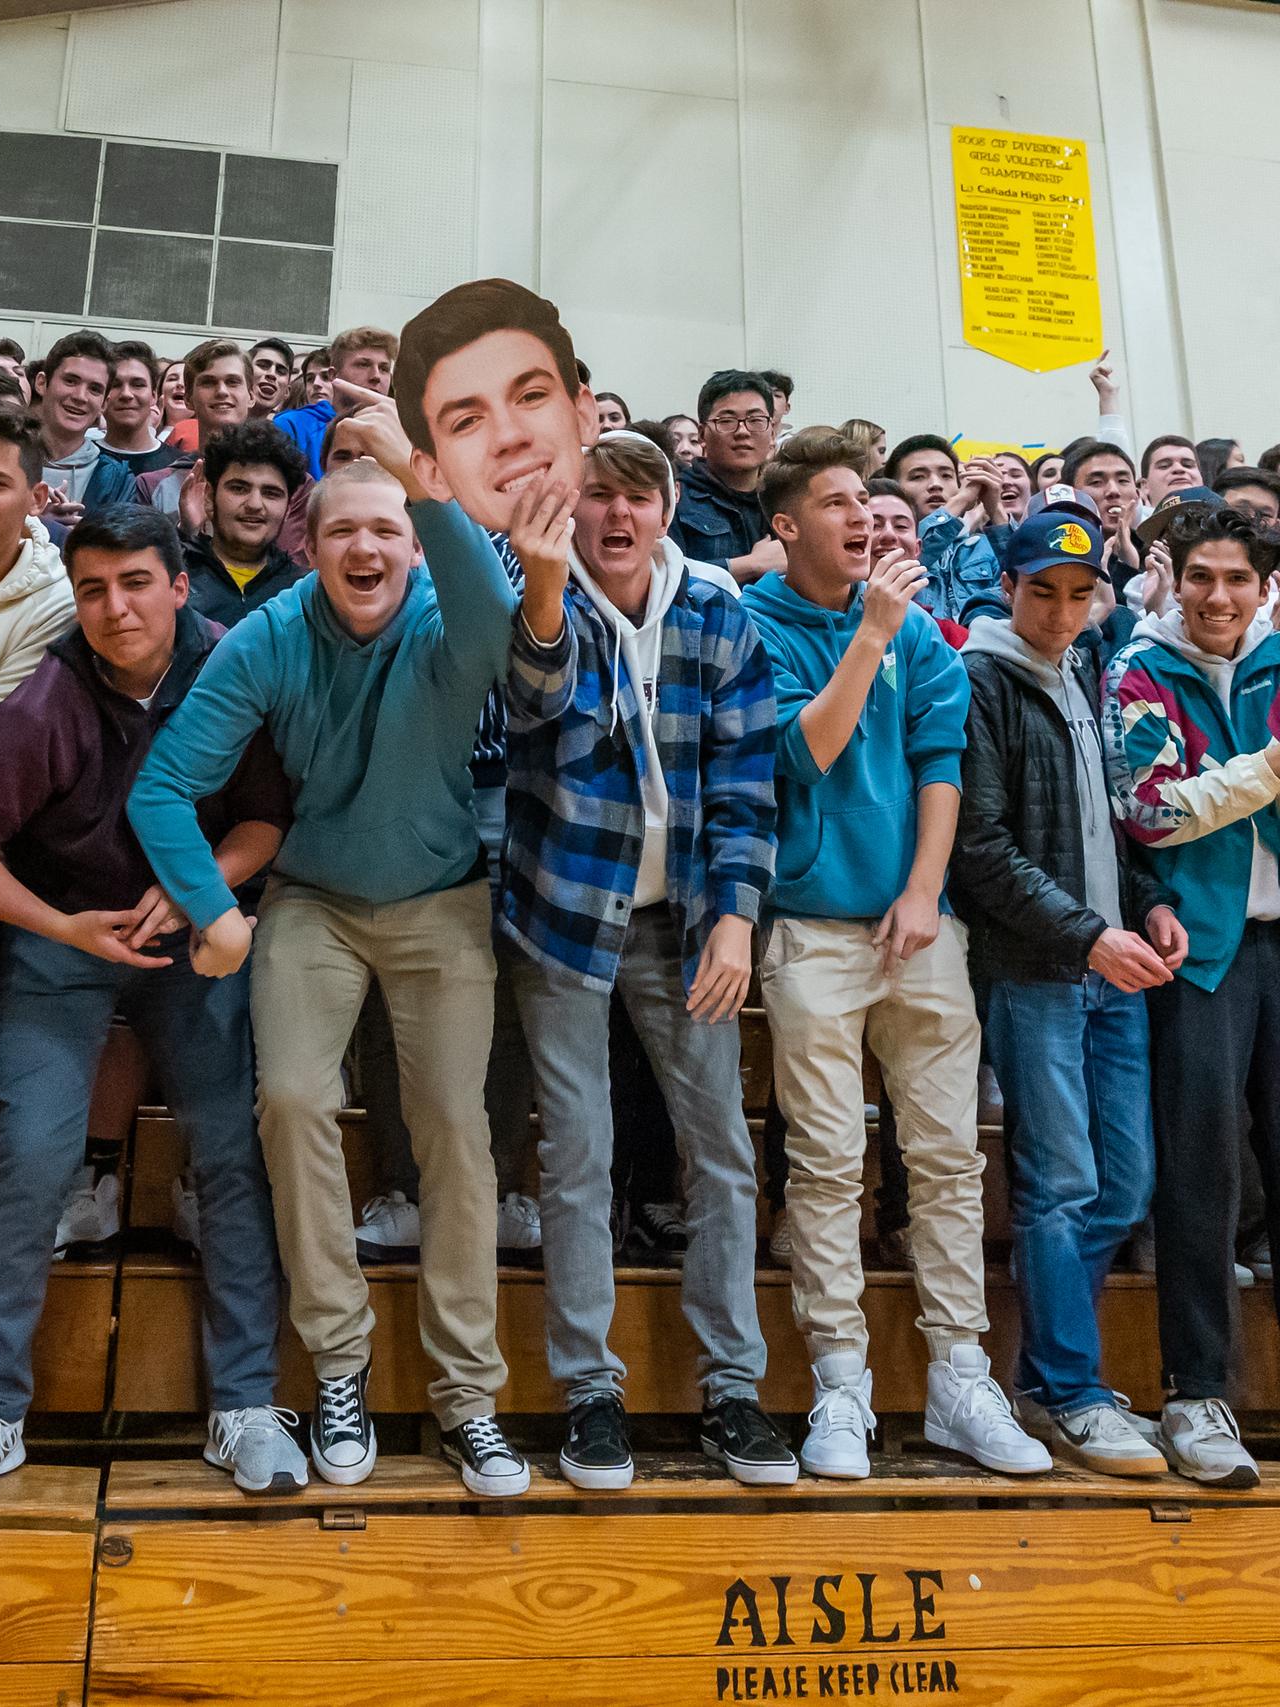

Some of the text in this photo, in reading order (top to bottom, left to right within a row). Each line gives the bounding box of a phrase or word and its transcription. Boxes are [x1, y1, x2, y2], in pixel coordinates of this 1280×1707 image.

[991, 138, 1008, 148] CIF
[1012, 141, 1061, 155] DIVISION
[970, 152, 1000, 162] GIRLS
[980, 166, 1064, 184] CHAMPIONSHIP
[978, 184, 1018, 198] Cañada
[1020, 190, 1046, 202] High
[714, 1570, 946, 1647] AISLE
[716, 1660, 959, 1701] PLEASE KEEP CLEAR
